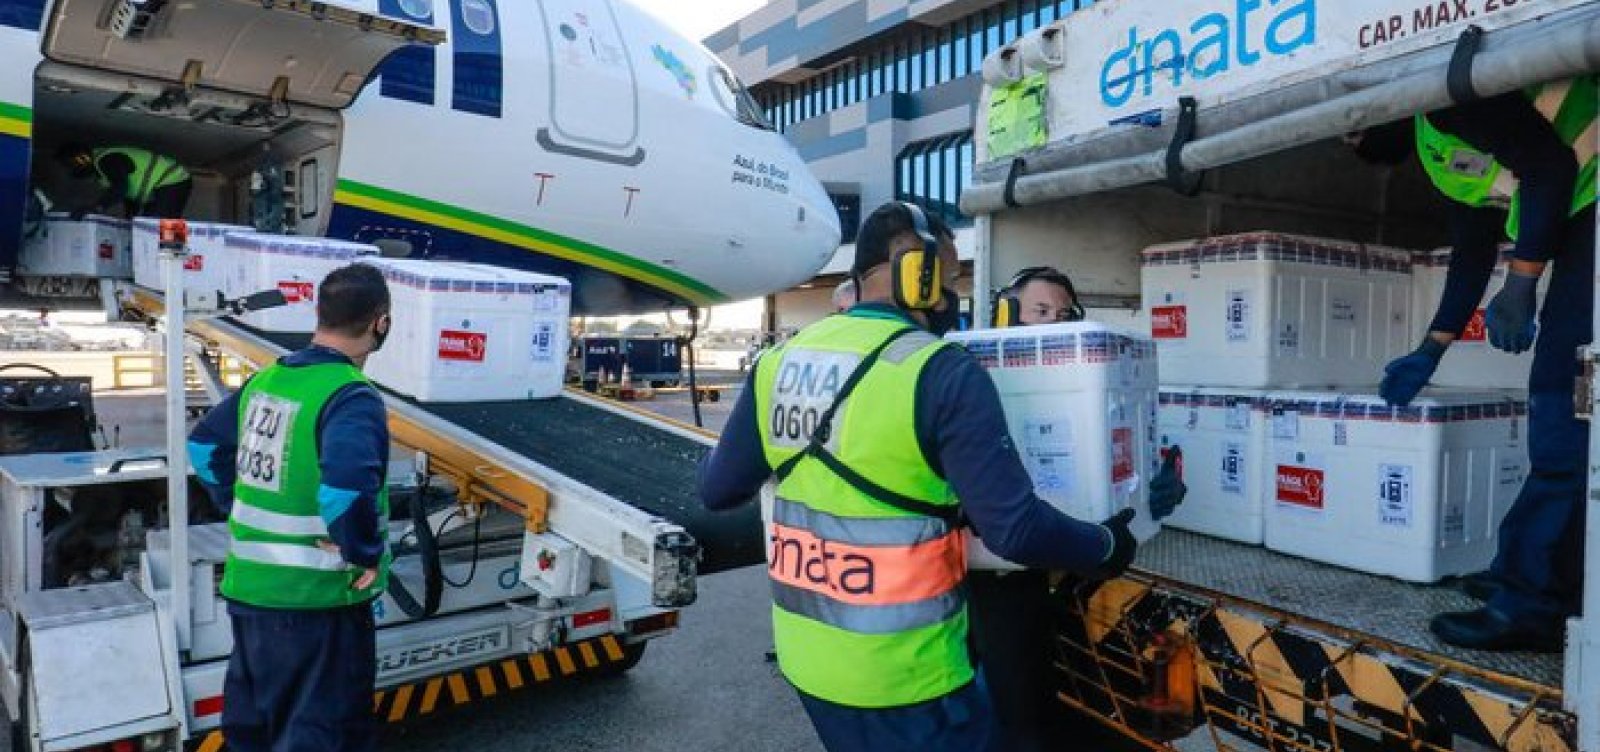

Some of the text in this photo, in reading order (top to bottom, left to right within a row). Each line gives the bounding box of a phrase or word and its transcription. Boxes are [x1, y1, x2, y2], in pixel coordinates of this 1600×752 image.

[1358, 15, 1407, 49] CAP.
[1100, 0, 1316, 107] dnata
[776, 362, 840, 397] DNA
[375, 632, 500, 672] UCKER
